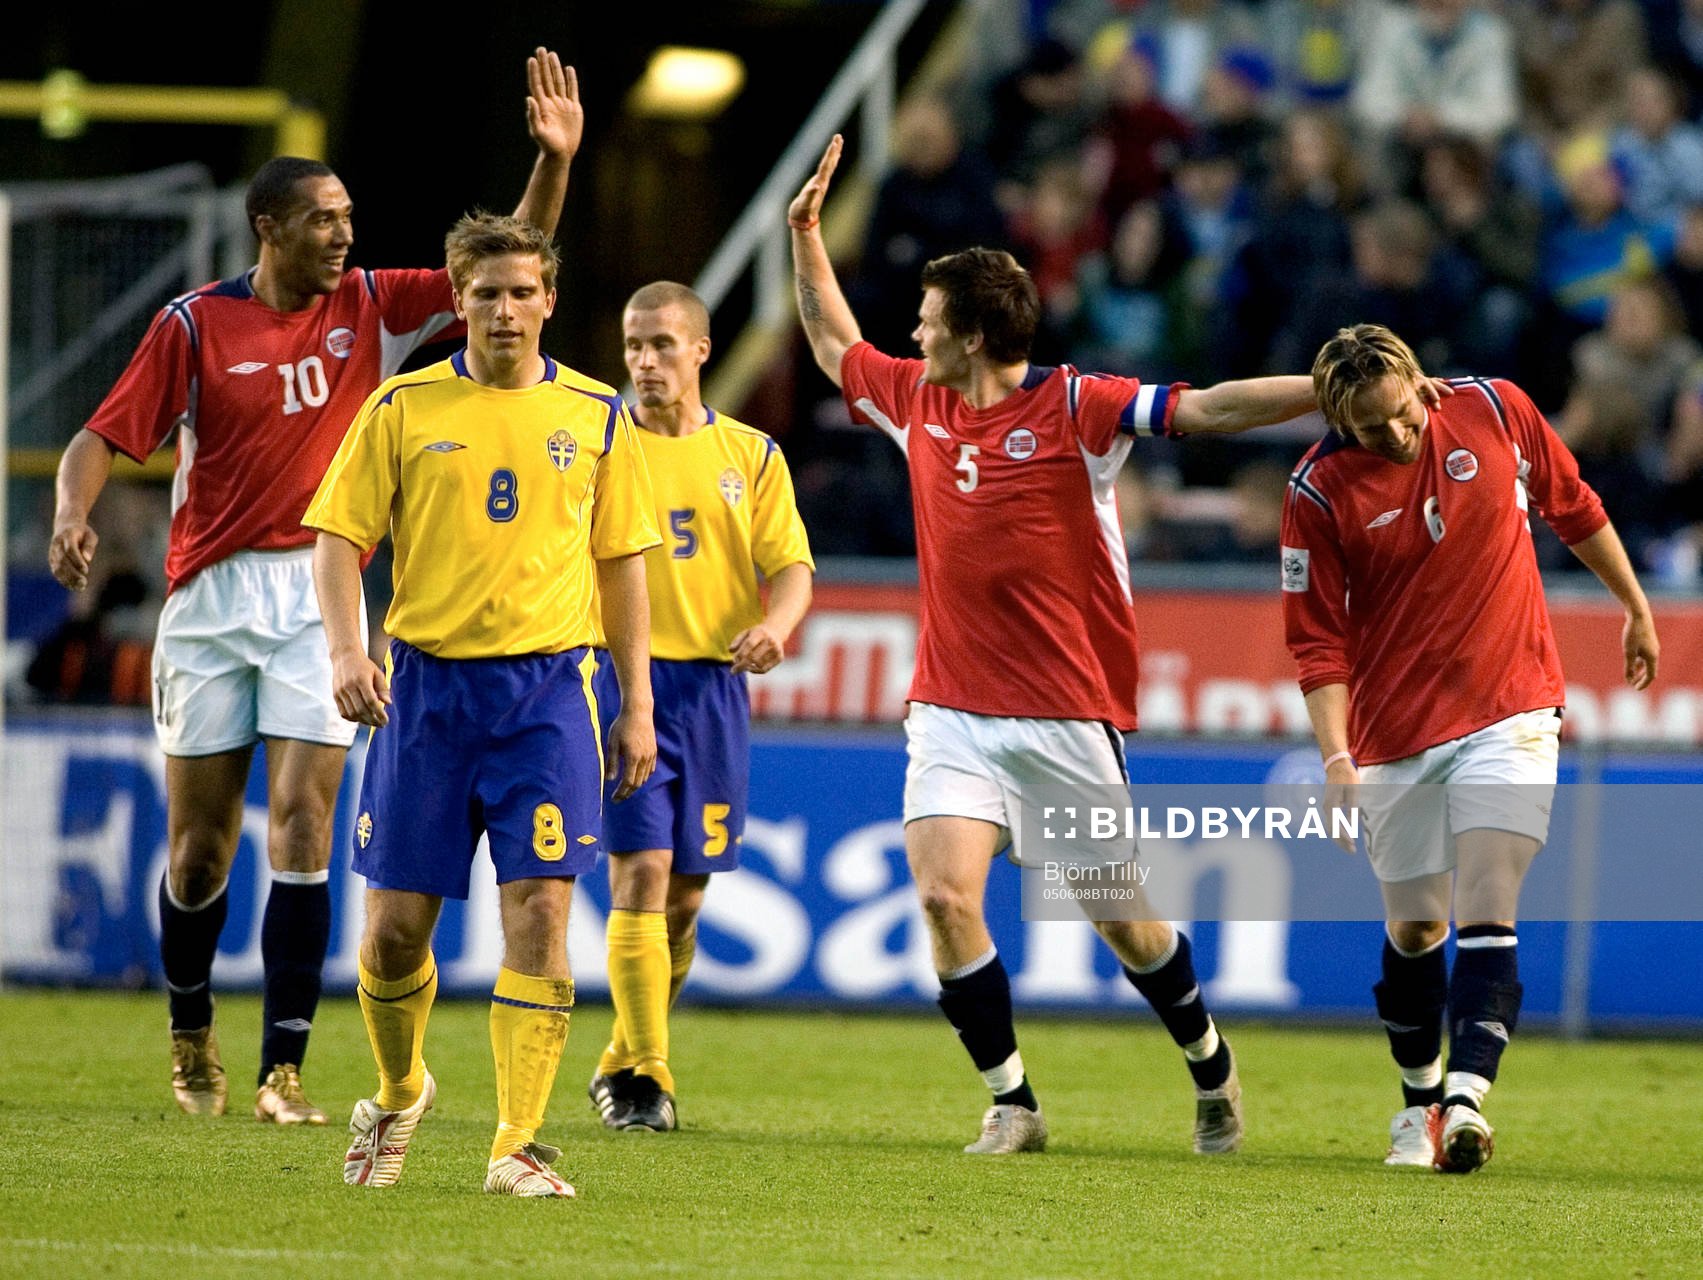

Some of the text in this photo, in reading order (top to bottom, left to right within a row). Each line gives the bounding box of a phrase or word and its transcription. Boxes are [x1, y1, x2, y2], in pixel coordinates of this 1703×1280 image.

[277, 355, 330, 415] 10
[486, 468, 518, 522] 8
[954, 444, 981, 493] 5
[669, 508, 699, 559] 5
[533, 803, 567, 862] 8
[702, 803, 731, 857] 5
[2, 734, 1303, 1005] Fsam
